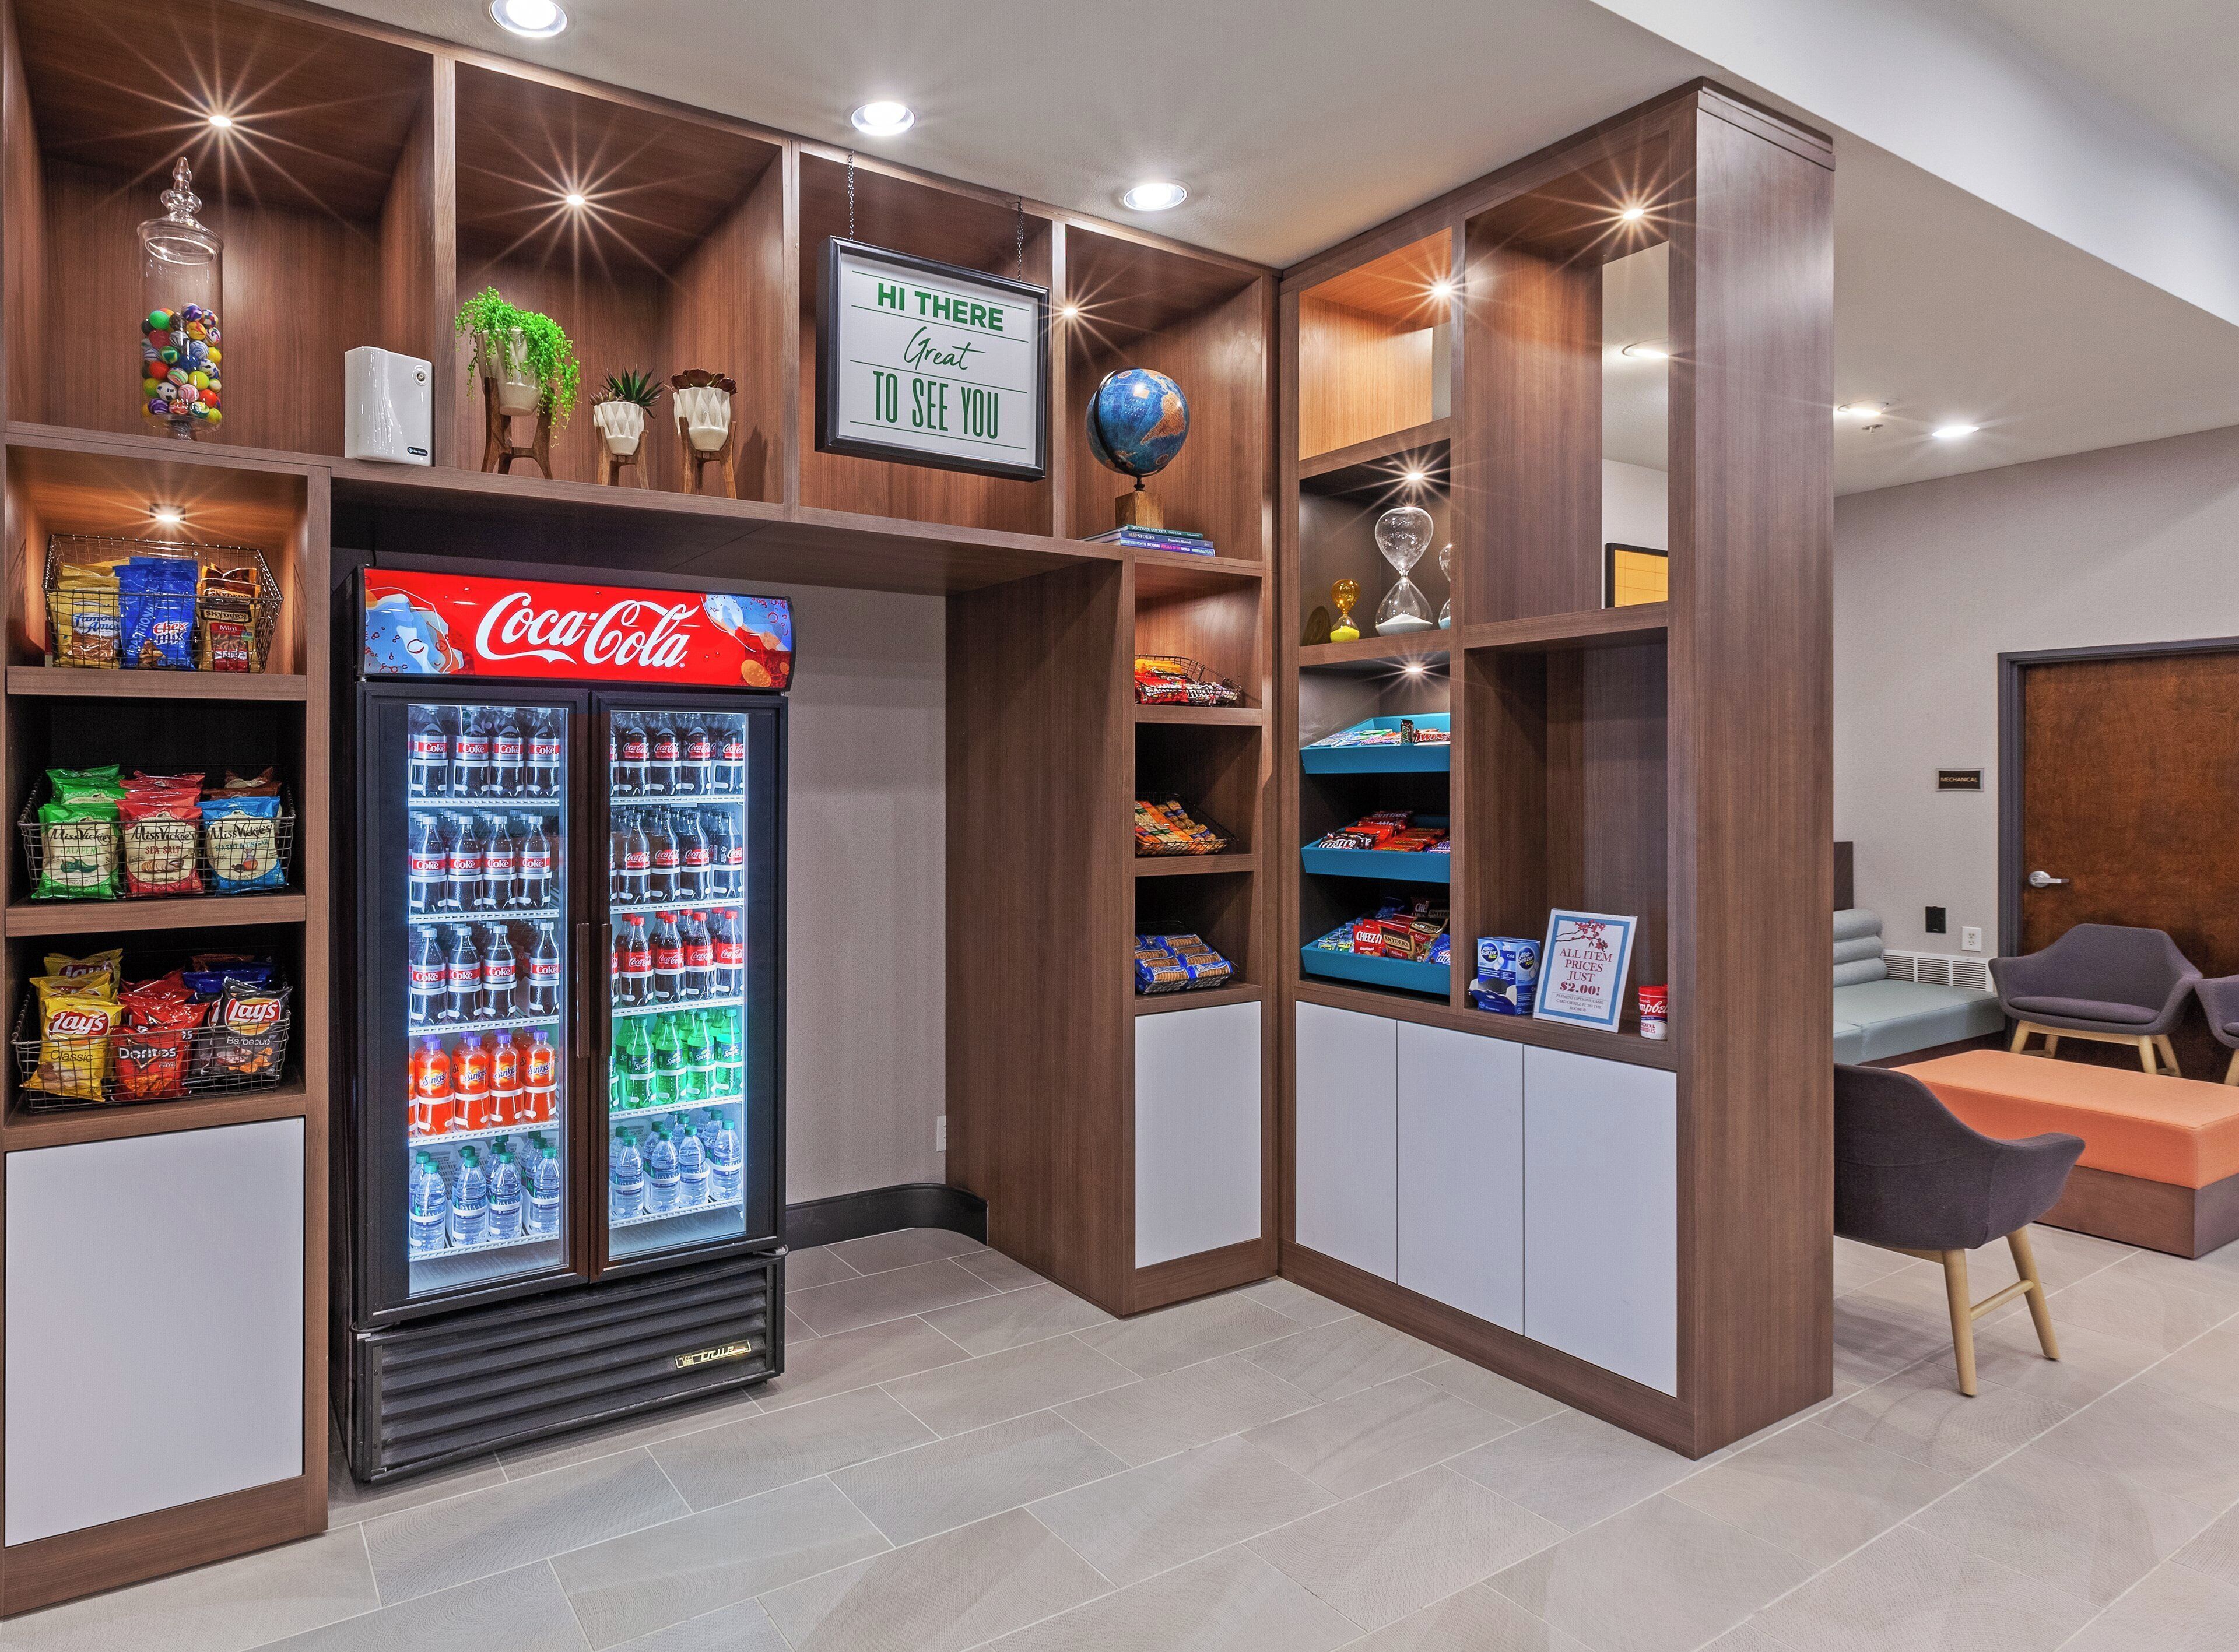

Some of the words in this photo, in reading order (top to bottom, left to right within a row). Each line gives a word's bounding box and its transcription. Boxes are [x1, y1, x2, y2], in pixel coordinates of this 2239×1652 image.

[878, 283, 905, 311] HI
[914, 290, 1003, 332] THERE
[904, 326, 986, 370] Great
[873, 371, 897, 423] TO
[912, 378, 948, 431] SEE
[961, 386, 998, 440] YOU
[153, 621, 188, 634] Chex
[476, 592, 700, 667] Coca-Cola
[425, 743, 445, 752] Coke
[463, 744, 485, 753] Coke
[500, 744, 520, 753] Coke
[535, 746, 555, 754] Coke
[145, 846, 159, 855] SEA
[416, 860, 438, 869] Coke
[454, 859, 475, 869] Coke
[487, 859, 509, 867] Coke
[522, 859, 543, 867] Coke
[1559, 948, 1580, 958] ALL
[1583, 950, 1613, 962] ITEM
[536, 966, 557, 974] Coke
[1564, 959, 1603, 972] PRICES
[451, 971, 473, 980] Coke
[489, 968, 511, 976] Coke
[1567, 971, 1595, 982] JUST
[416, 973, 438, 982] Coke
[1560, 981, 1600, 996] $2.00!
[228, 1000, 278, 1022] Lay's
[50, 1012, 106, 1035] Lay's
[227, 1036, 270, 1046] Barbecue
[51, 1050, 93, 1062] Classic
[119, 1047, 177, 1059] Doritos
[423, 1071, 447, 1086] Snkist
